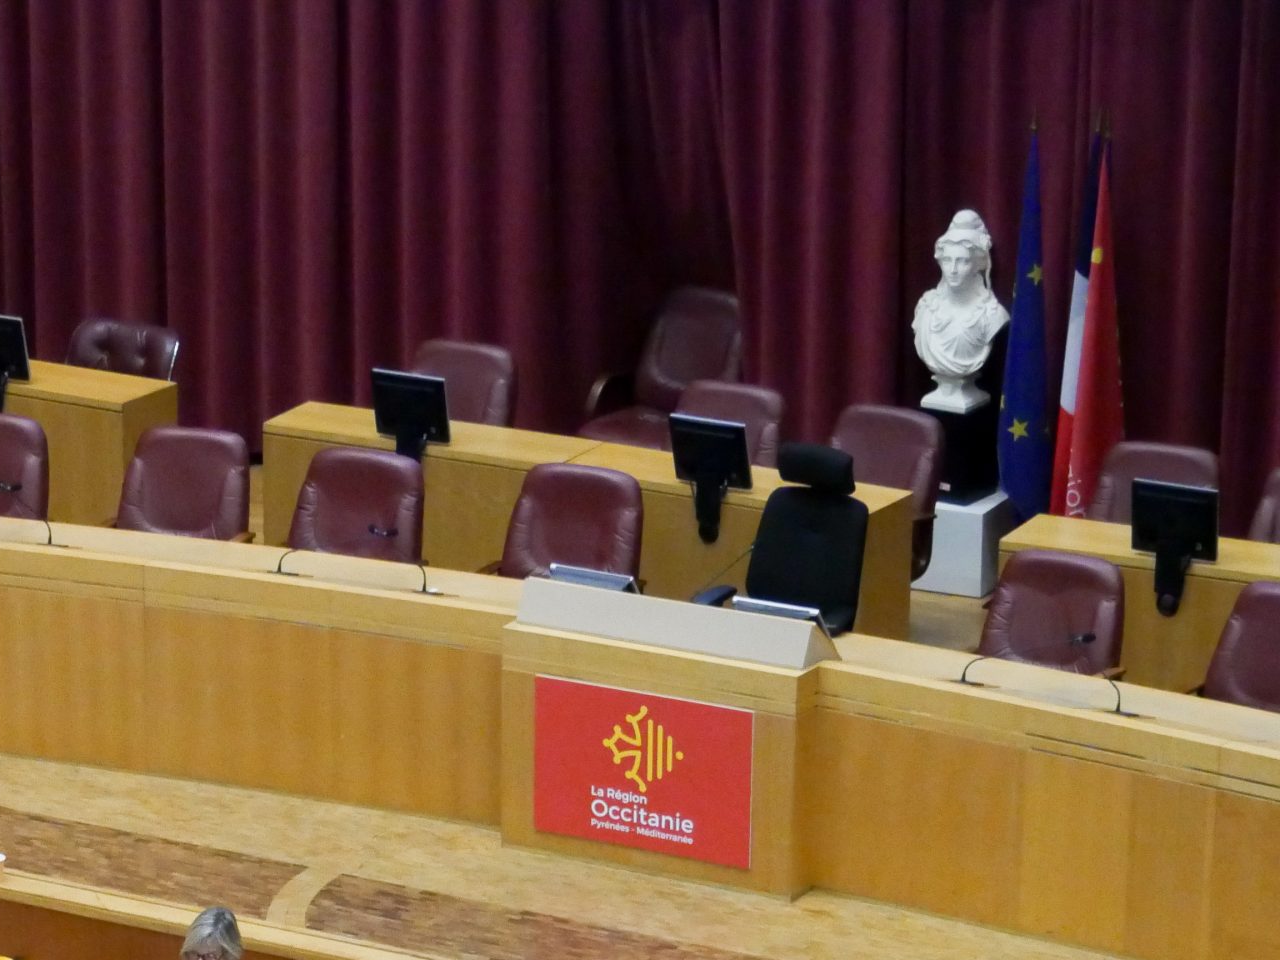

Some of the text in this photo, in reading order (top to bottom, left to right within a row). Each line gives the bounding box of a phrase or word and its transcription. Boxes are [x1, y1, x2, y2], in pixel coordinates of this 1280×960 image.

[591, 785, 648, 805] La Région
[591, 799, 694, 833] Occitanie
[590, 818, 630, 832] Pyrénées
[636, 826, 694, 845] Méditerranée
